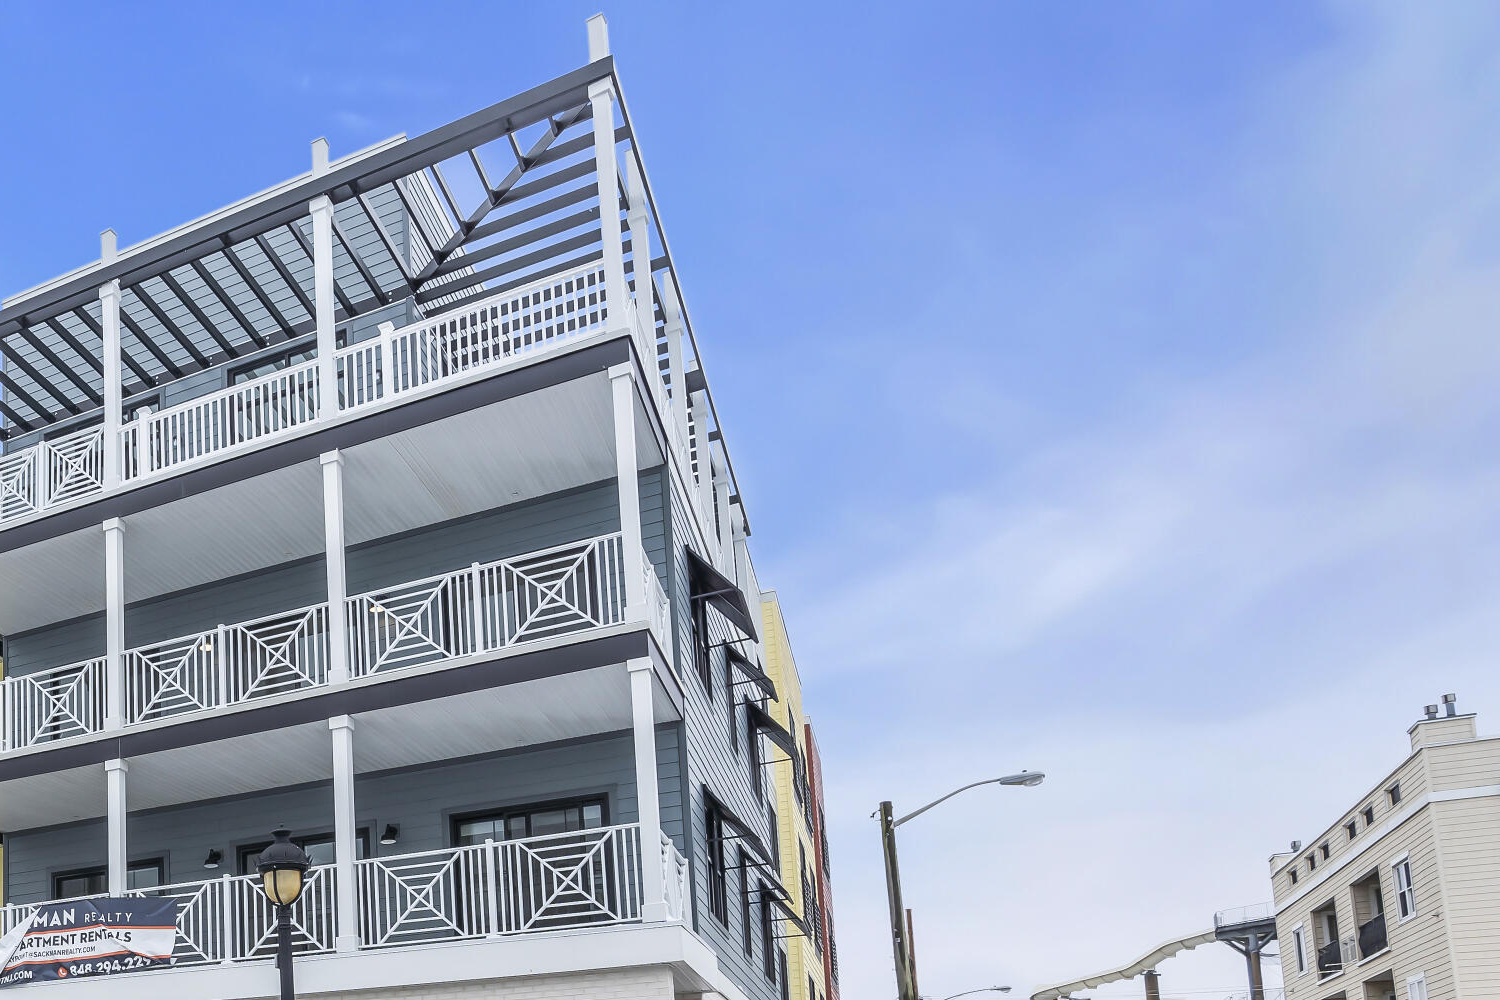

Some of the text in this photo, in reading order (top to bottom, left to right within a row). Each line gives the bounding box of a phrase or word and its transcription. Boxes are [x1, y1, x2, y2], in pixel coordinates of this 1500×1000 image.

[29, 908, 133, 928] MAN REALTY
[80, 929, 132, 944] RENTALS
